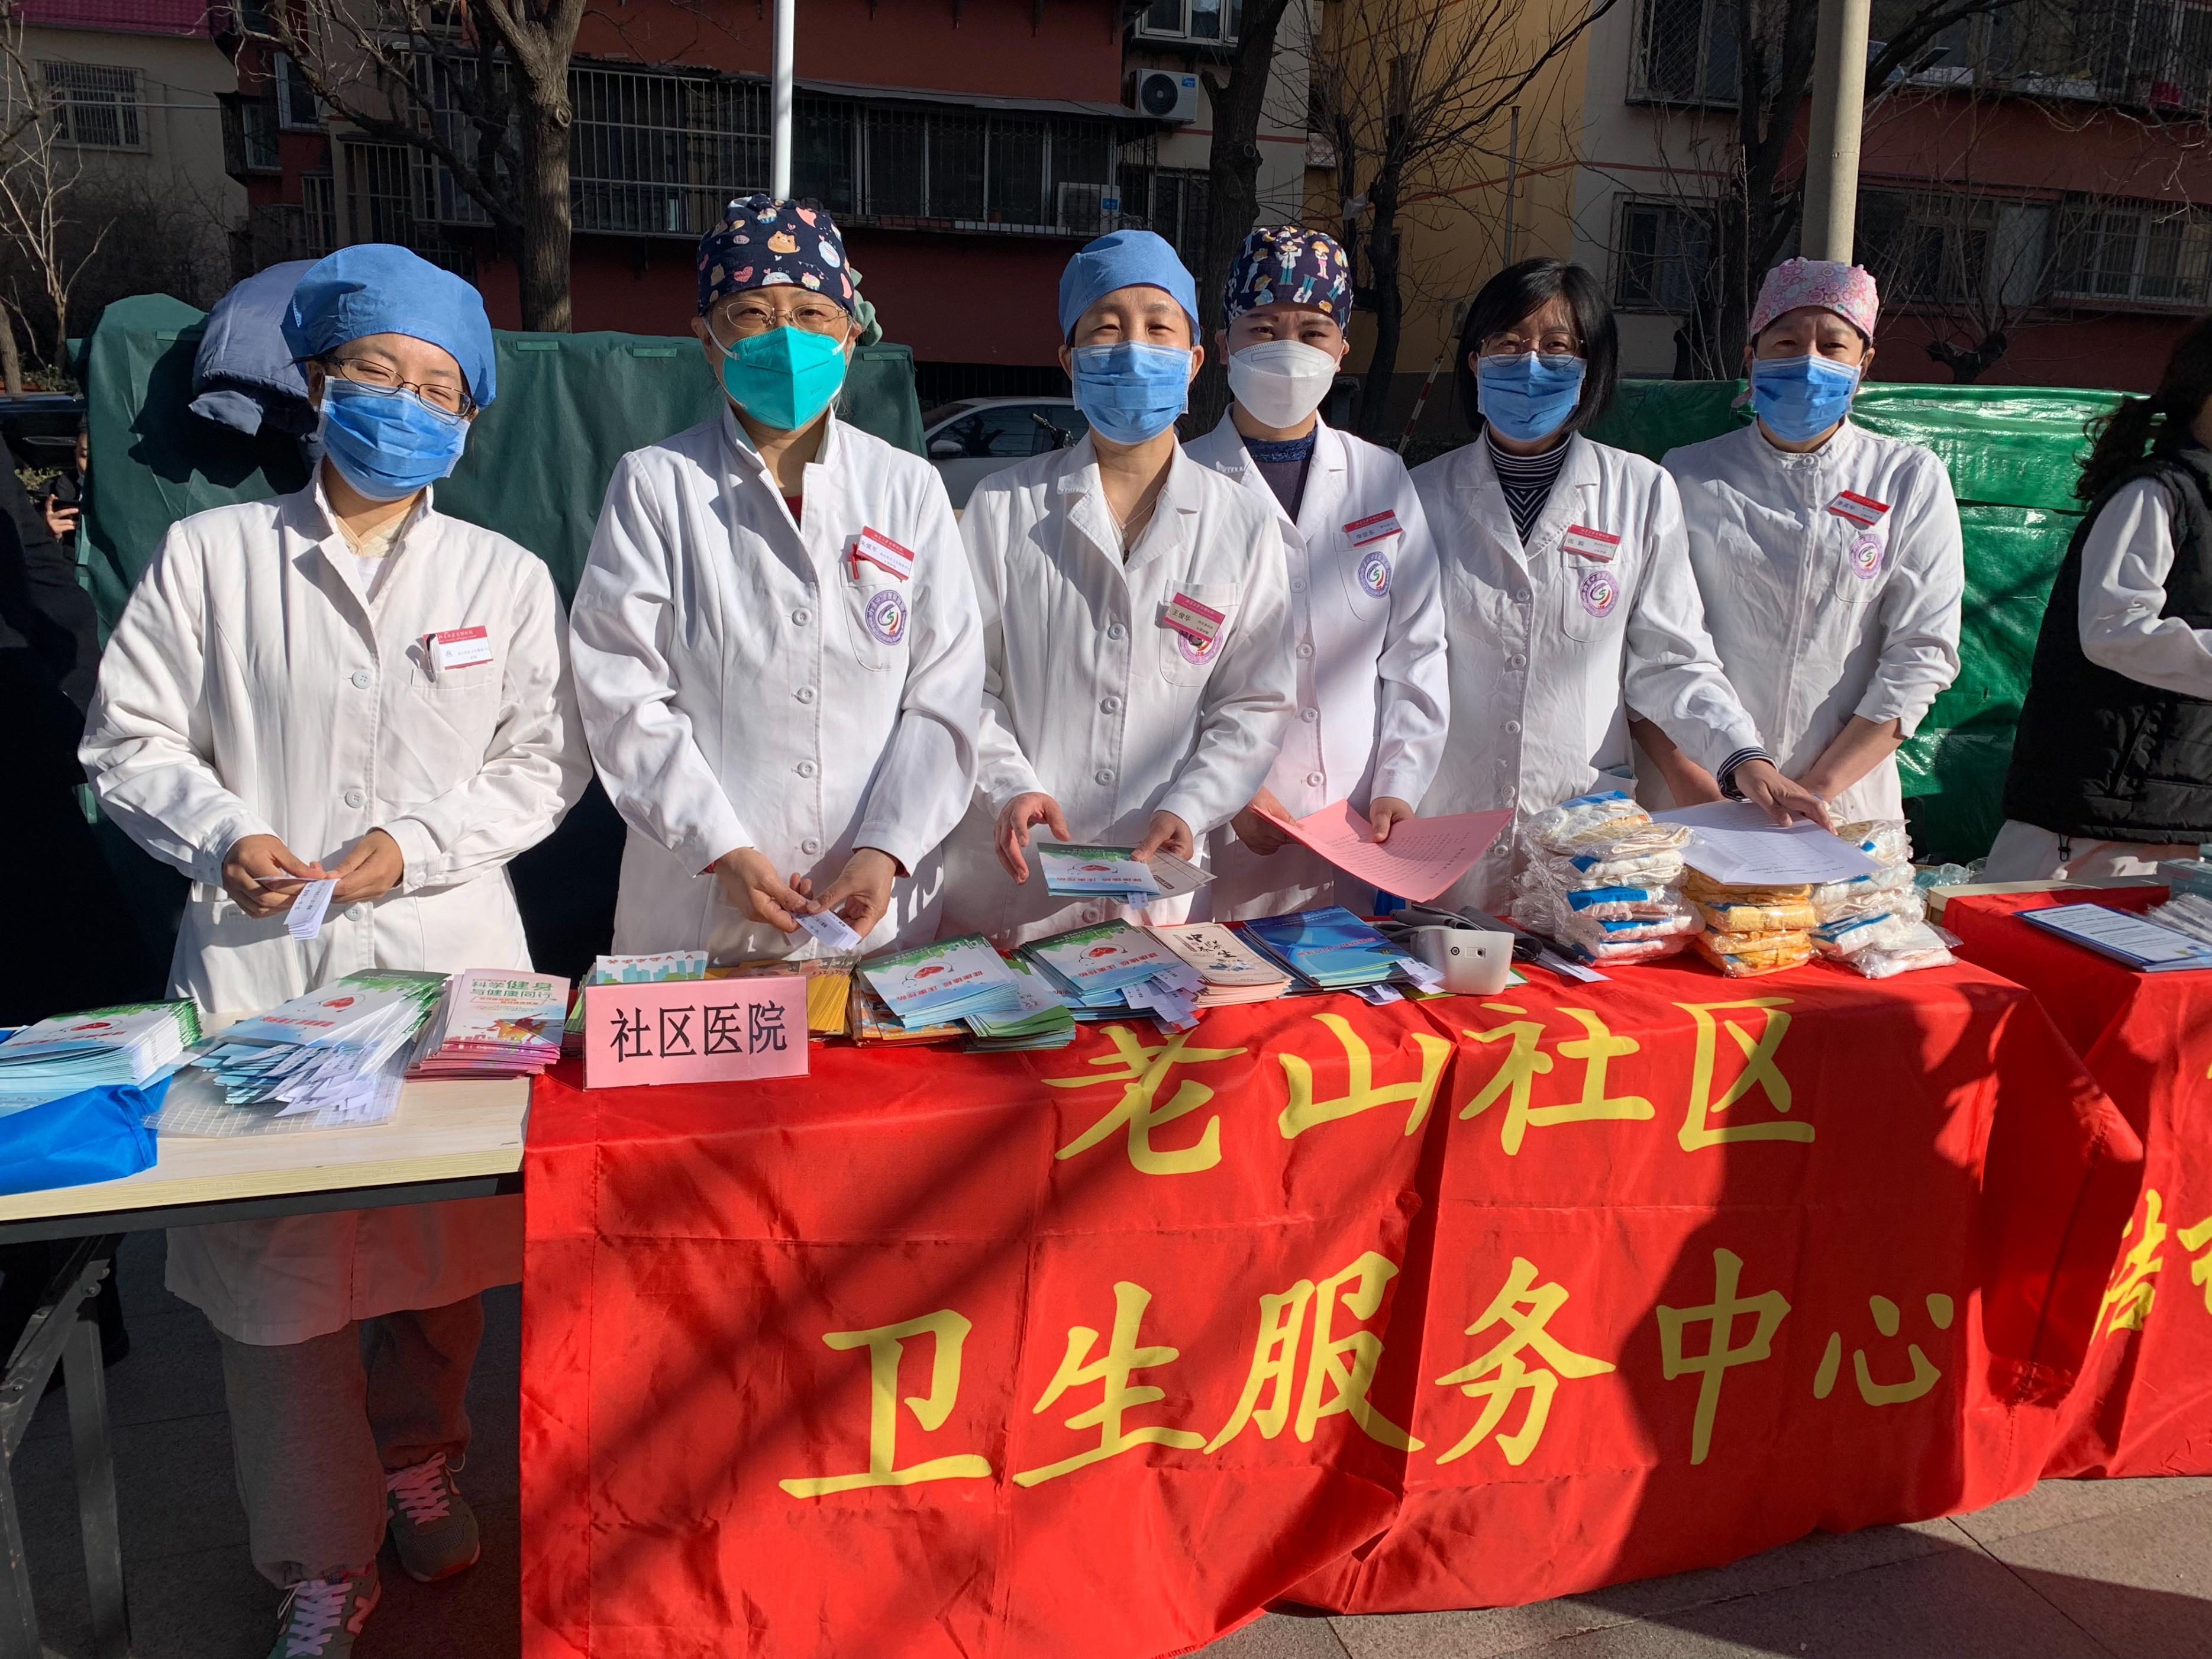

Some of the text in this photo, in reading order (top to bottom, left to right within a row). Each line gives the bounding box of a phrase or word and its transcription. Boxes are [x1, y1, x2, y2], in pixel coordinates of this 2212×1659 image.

[470, 989, 556, 1000] 与健康同行
[472, 980, 554, 992] 科学健身
[609, 999, 788, 1063] 社区医院
[1041, 997, 1815, 1176] 老山社区
[779, 1247, 1954, 1499] 卫生服务中心
